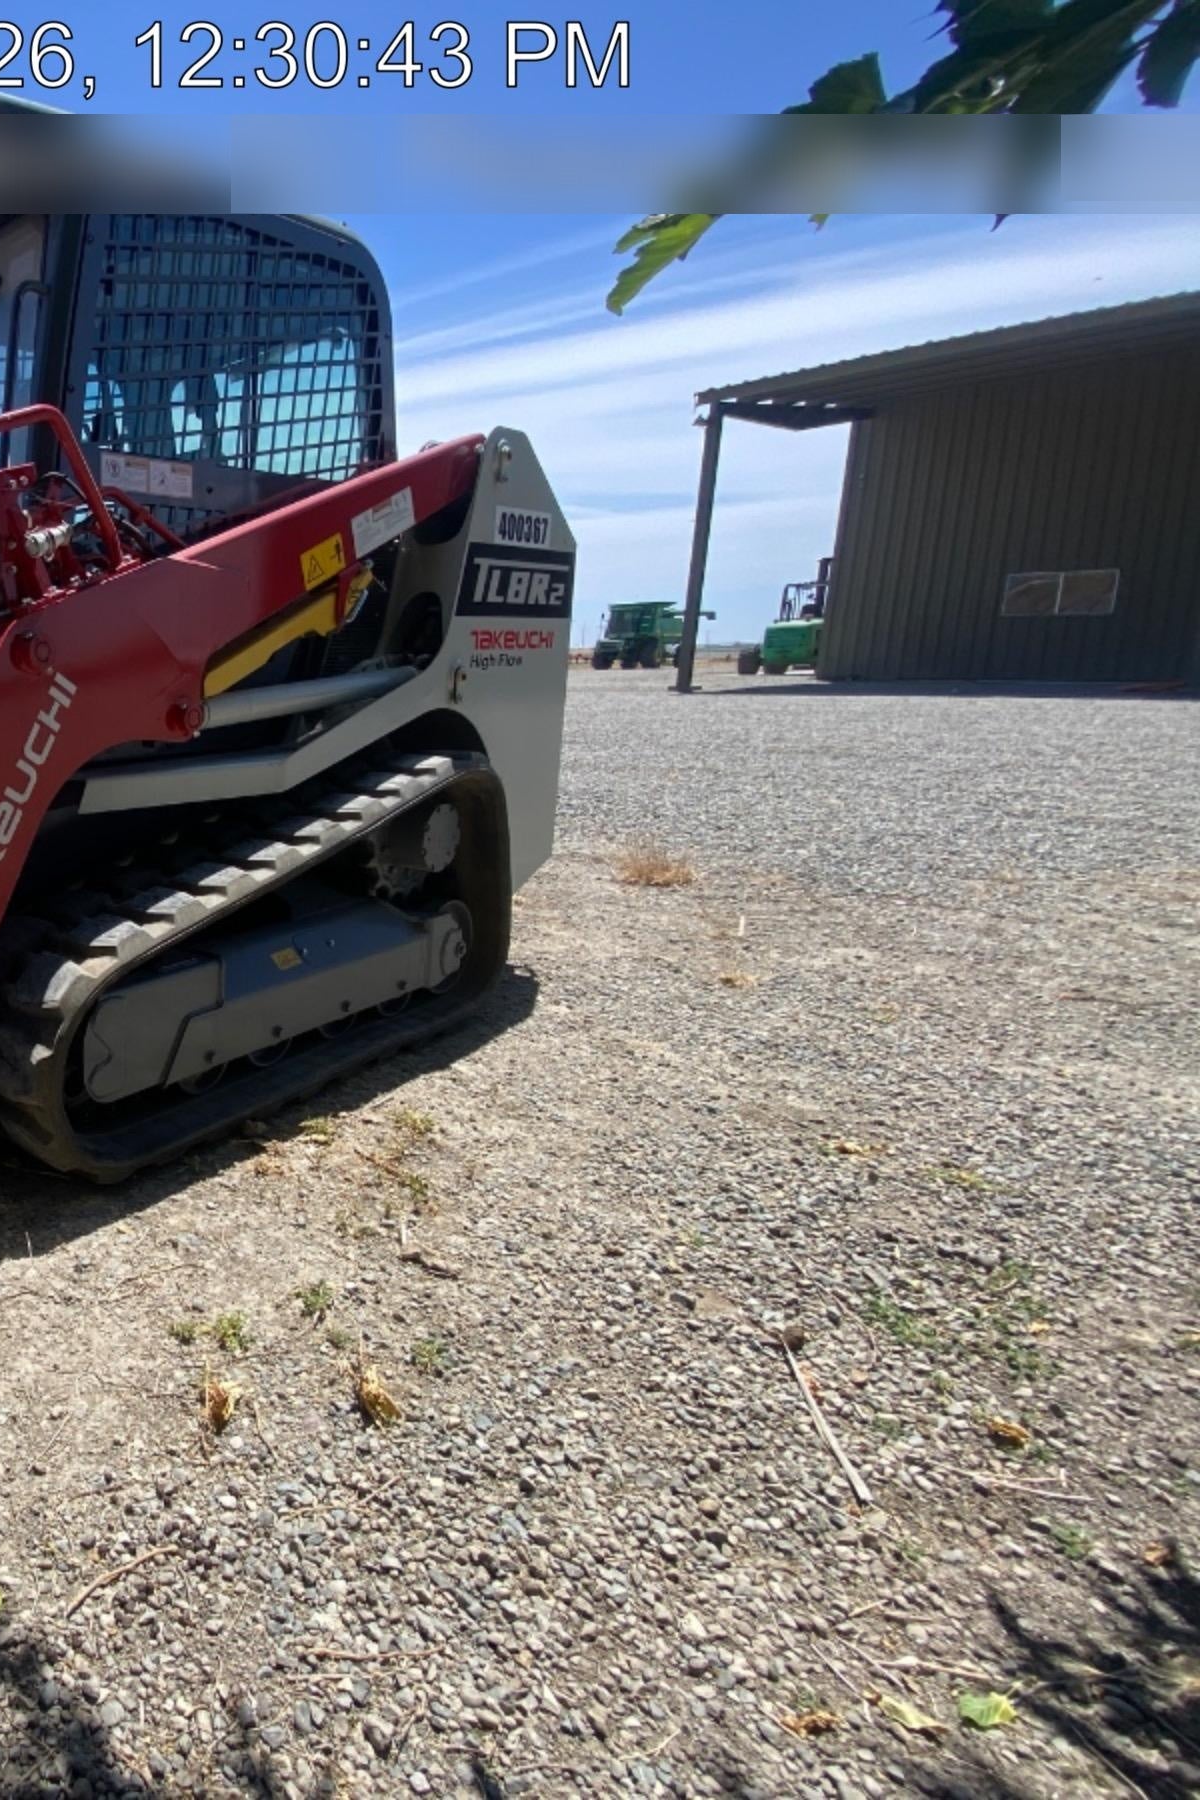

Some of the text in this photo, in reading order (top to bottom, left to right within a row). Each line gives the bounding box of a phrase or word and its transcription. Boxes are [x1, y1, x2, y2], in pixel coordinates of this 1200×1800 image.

[498, 512, 548, 544] 400367
[470, 629, 554, 650] TAKEUCHI
[470, 653, 523, 670] High Flow
